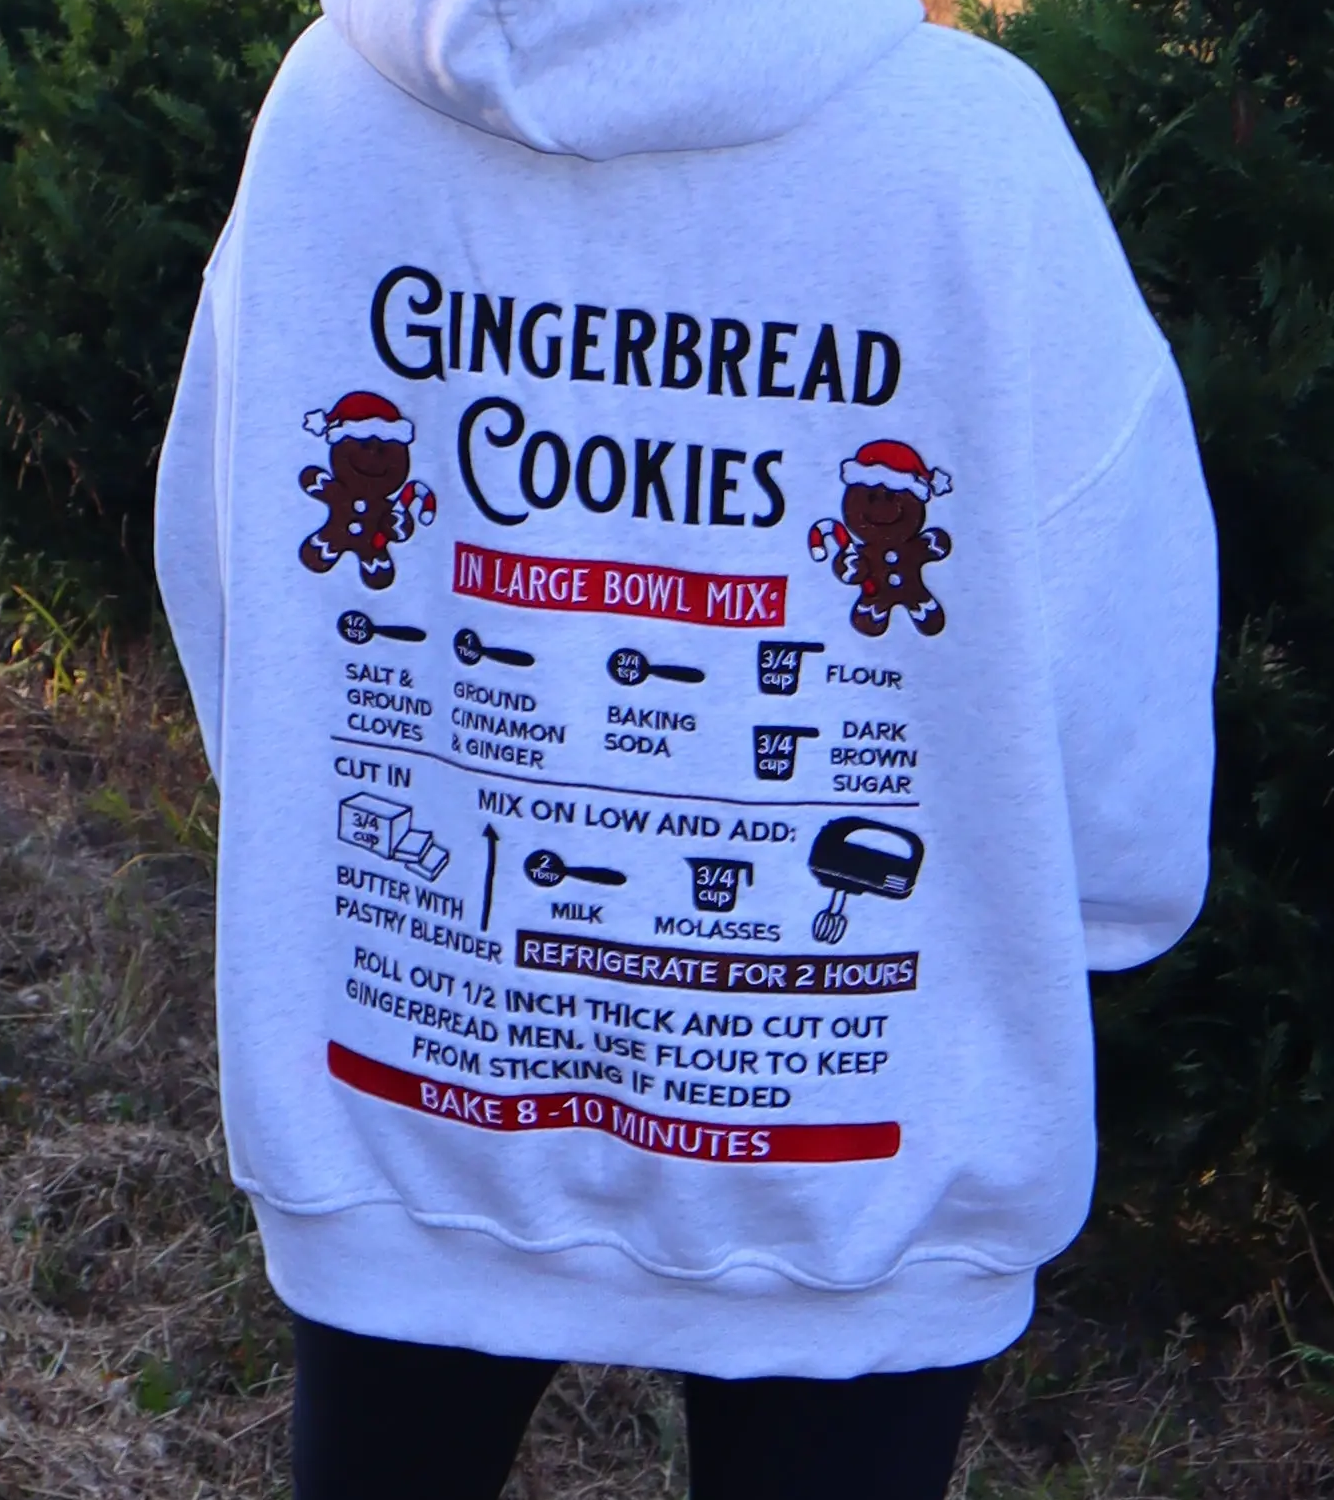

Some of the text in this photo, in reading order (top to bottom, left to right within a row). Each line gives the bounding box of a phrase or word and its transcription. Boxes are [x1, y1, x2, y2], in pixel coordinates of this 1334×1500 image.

[371, 266, 901, 406] GINGERBREAD
[457, 397, 786, 527] COOKIES
[458, 551, 778, 622] IN LARGE BOWL MIX:
[345, 628, 367, 641] tsp
[617, 652, 639, 668] 3/4
[761, 649, 797, 669] 3/4
[346, 663, 414, 689] SALT &
[616, 667, 639, 682] tsp
[762, 672, 794, 690] cup
[827, 665, 905, 689] FLOUR
[347, 688, 432, 716] GROUND
[453, 682, 536, 712] GROUND
[348, 714, 423, 742] CLOVES
[451, 708, 566, 744] CINNAMON
[608, 706, 696, 731] BAKING
[757, 734, 793, 754] 3/4
[843, 721, 907, 742] DARK
[451, 734, 544, 769] & GINGER
[604, 734, 671, 758] SODA
[830, 748, 917, 768] BROWN
[335, 756, 411, 788] CUT IN
[758, 758, 789, 776] cup
[833, 775, 912, 794] SUGAR
[351, 813, 379, 832] 3/4
[479, 789, 797, 843] MIX ON LOW AND ADD:
[353, 832, 380, 850] cup
[540, 855, 550, 868] 2
[696, 867, 736, 887] 3/4
[337, 865, 464, 921] BUTTER WITH
[698, 889, 732, 907] cup
[551, 903, 604, 924] MILK
[335, 895, 503, 964] PASTRY BLENDER
[654, 917, 781, 942] MOLASSES
[523, 939, 914, 989] REFRIGERATE FOR 2 HOURS
[354, 946, 888, 1039] ROLL OUT 1/2 INCH THICK AND CUT OUT
[346, 978, 888, 1076] GINGERBREAD MEN. USE FLOUR TO KEEP
[412, 1035, 791, 1109] FROM STICKING IF NEEDED
[420, 1081, 503, 1125] BAKE
[517, 1101, 538, 1124] 8
[612, 1105, 772, 1158] MINUTES
